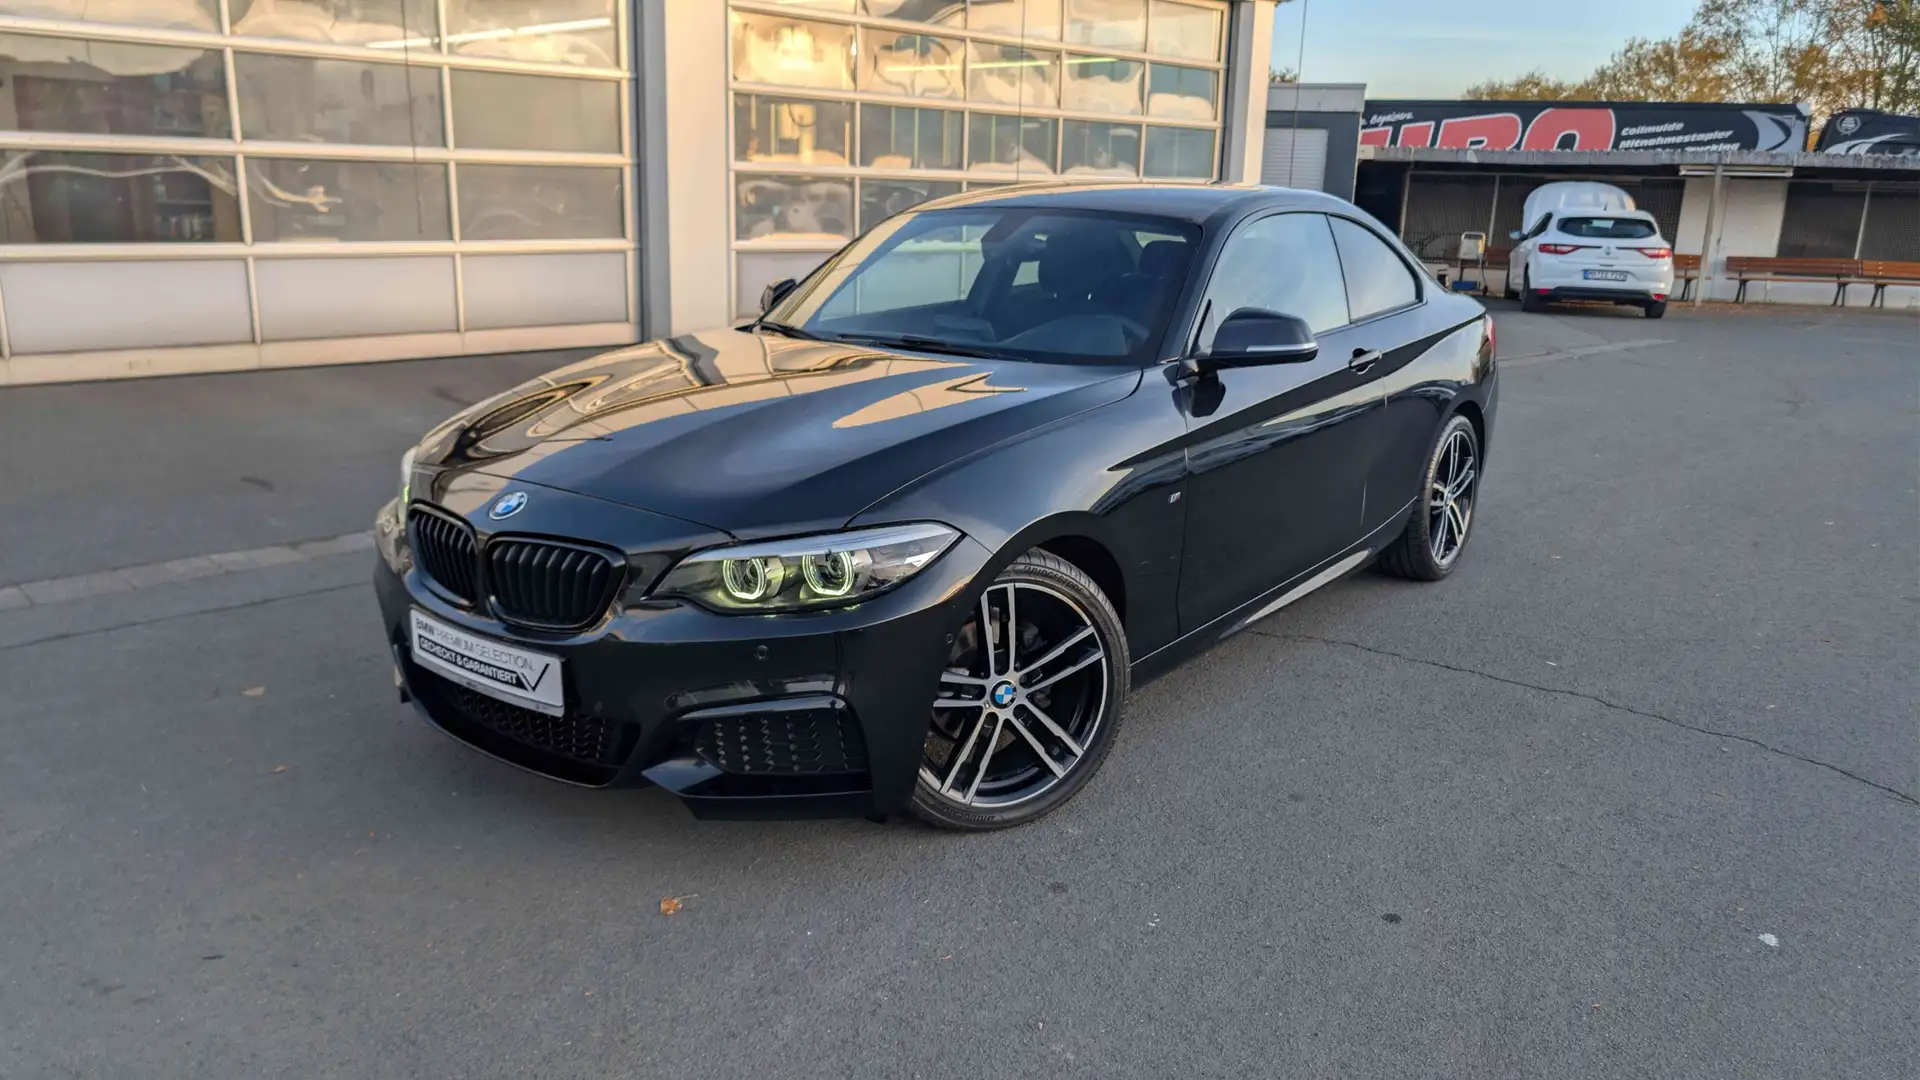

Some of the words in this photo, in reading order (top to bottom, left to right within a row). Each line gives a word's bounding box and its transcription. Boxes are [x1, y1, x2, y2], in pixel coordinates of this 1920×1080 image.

[416, 617, 435, 637] BMW
[435, 627, 475, 652] PREMIUM
[420, 637, 456, 663] GECHECKT
[456, 656, 462, 665] &
[462, 657, 517, 685] GARANTIERT
